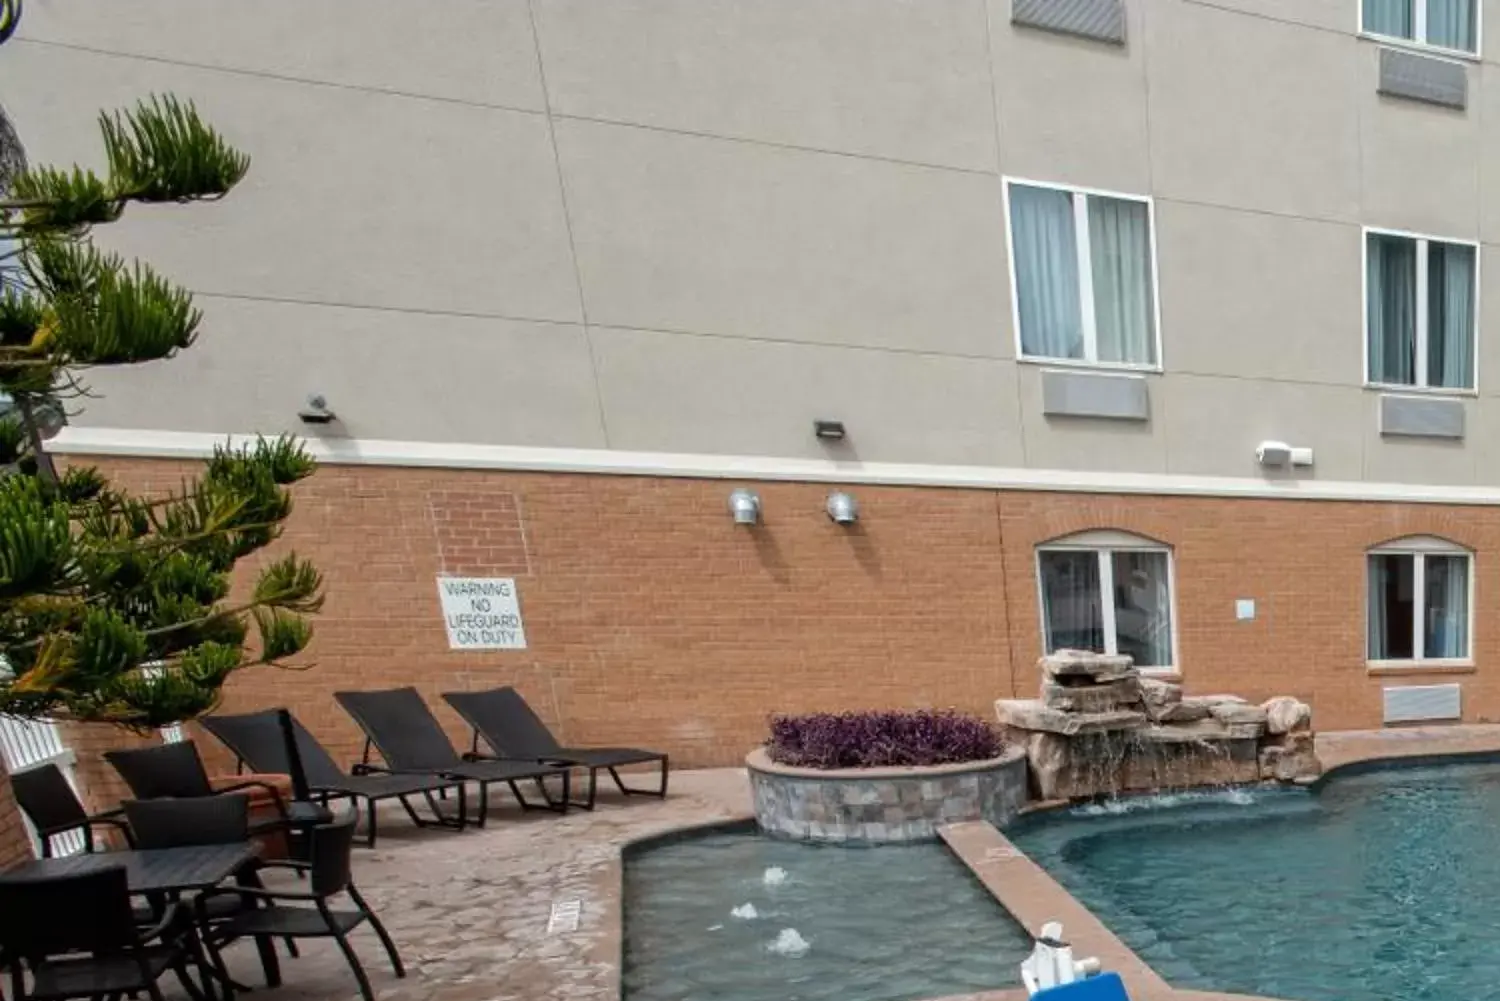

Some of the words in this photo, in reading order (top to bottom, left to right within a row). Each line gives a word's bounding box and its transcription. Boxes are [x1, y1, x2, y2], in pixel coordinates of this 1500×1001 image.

[445, 583, 511, 597] WARNING
[470, 598, 491, 612] NO
[448, 614, 519, 629] LIFEGUARD
[457, 630, 478, 644] ON
[481, 630, 516, 644] DUTY
